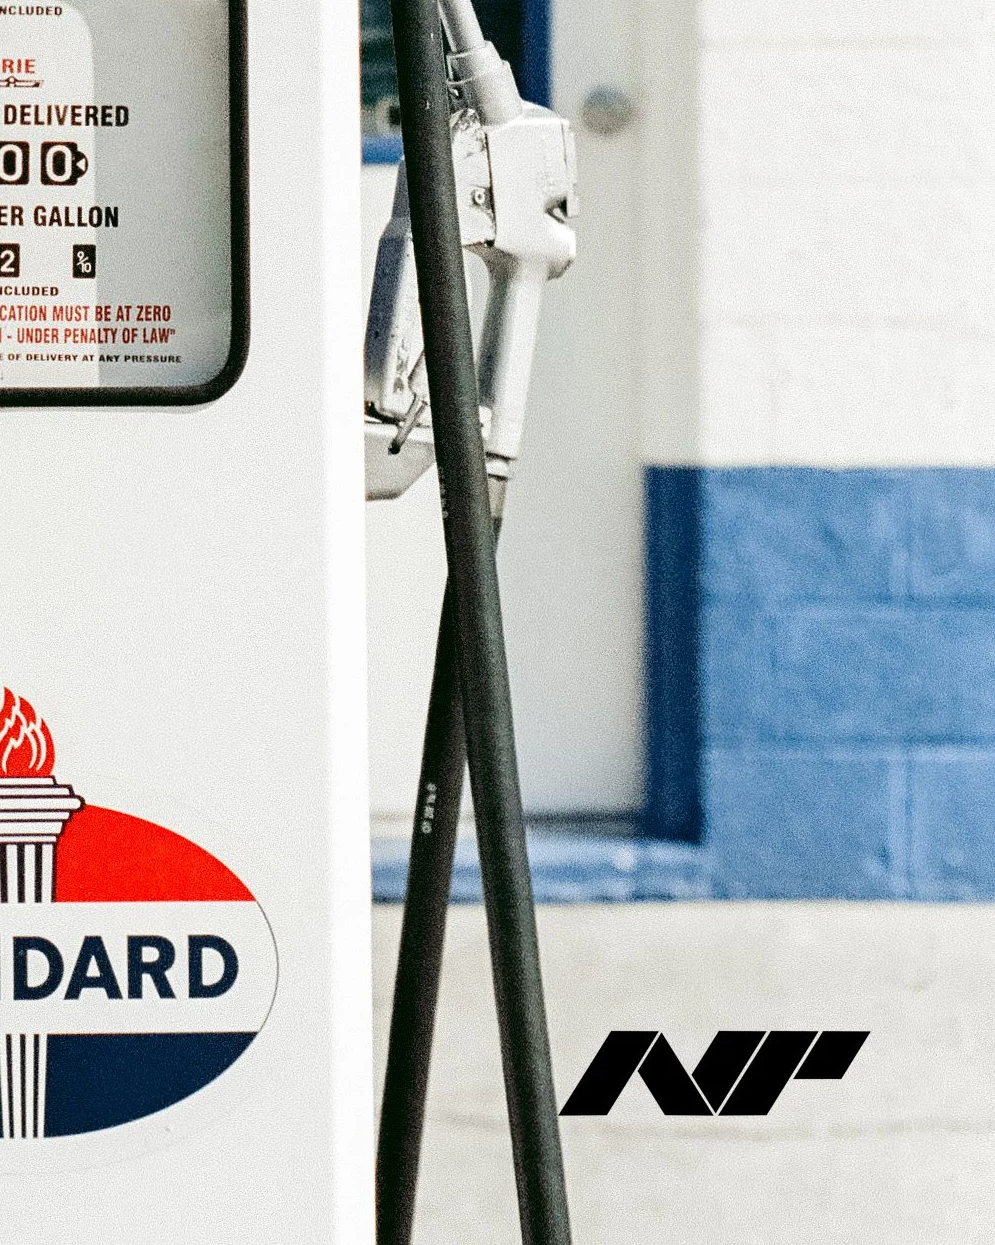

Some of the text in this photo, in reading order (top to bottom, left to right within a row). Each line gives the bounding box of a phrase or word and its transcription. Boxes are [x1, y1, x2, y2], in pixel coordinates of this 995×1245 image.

[4, 105, 129, 127] DELIVERED
[34, 206, 118, 227] GALLON
[0, 250, 16, 273] 2
[53, 306, 89, 321] MUST
[96, 305, 111, 321] BE
[116, 306, 132, 321] AT
[137, 306, 171, 321] ZERO
[18, 328, 58, 343] UNDER
[65, 328, 118, 344] PENALTY
[122, 328, 137, 343] OF
[7, 353, 21, 361] OF
[25, 353, 78, 362] DELIVERY
[82, 354, 94, 362] AT
[98, 354, 120, 362] ANY
[123, 354, 181, 364] PRESSURE
